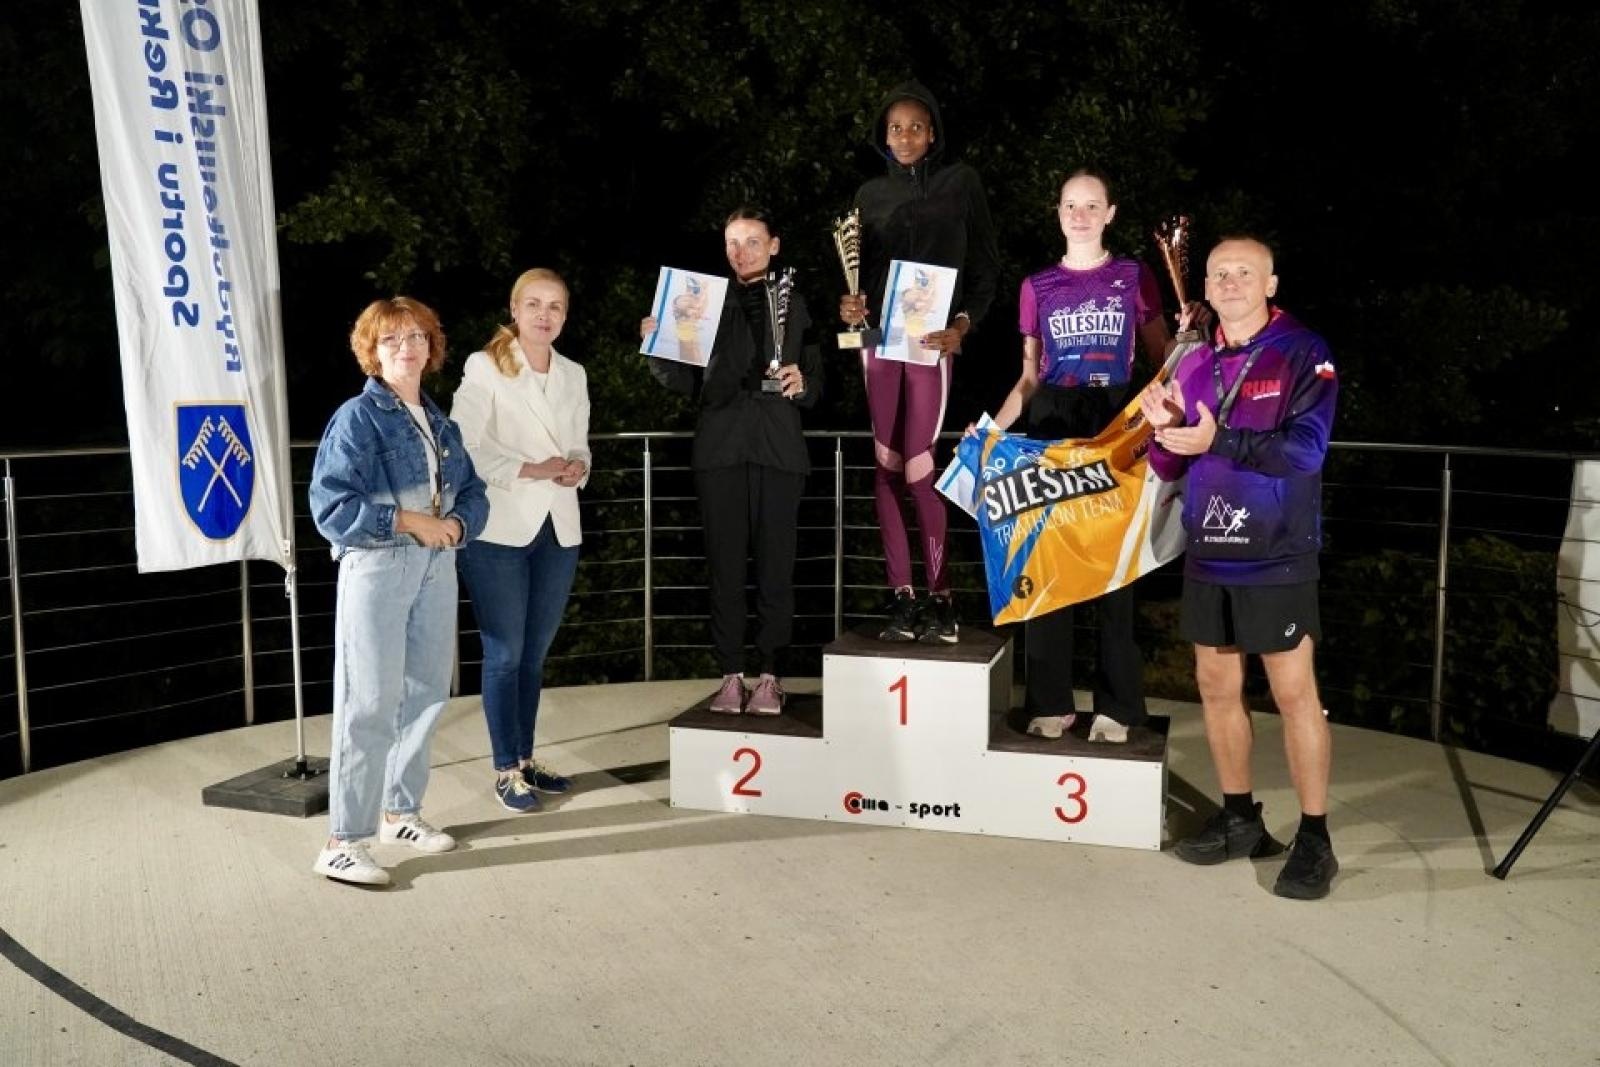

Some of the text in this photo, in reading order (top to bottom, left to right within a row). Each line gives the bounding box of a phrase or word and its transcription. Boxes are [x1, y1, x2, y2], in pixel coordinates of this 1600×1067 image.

[1051, 314, 1123, 336] SILESIAN
[984, 462, 1115, 521] SILESIAN
[993, 490, 1125, 548] TRIATHLON TEAM
[888, 674, 909, 726] 1
[731, 747, 763, 797] 2
[909, 802, 961, 819] sport
[1054, 773, 1088, 824] 3
